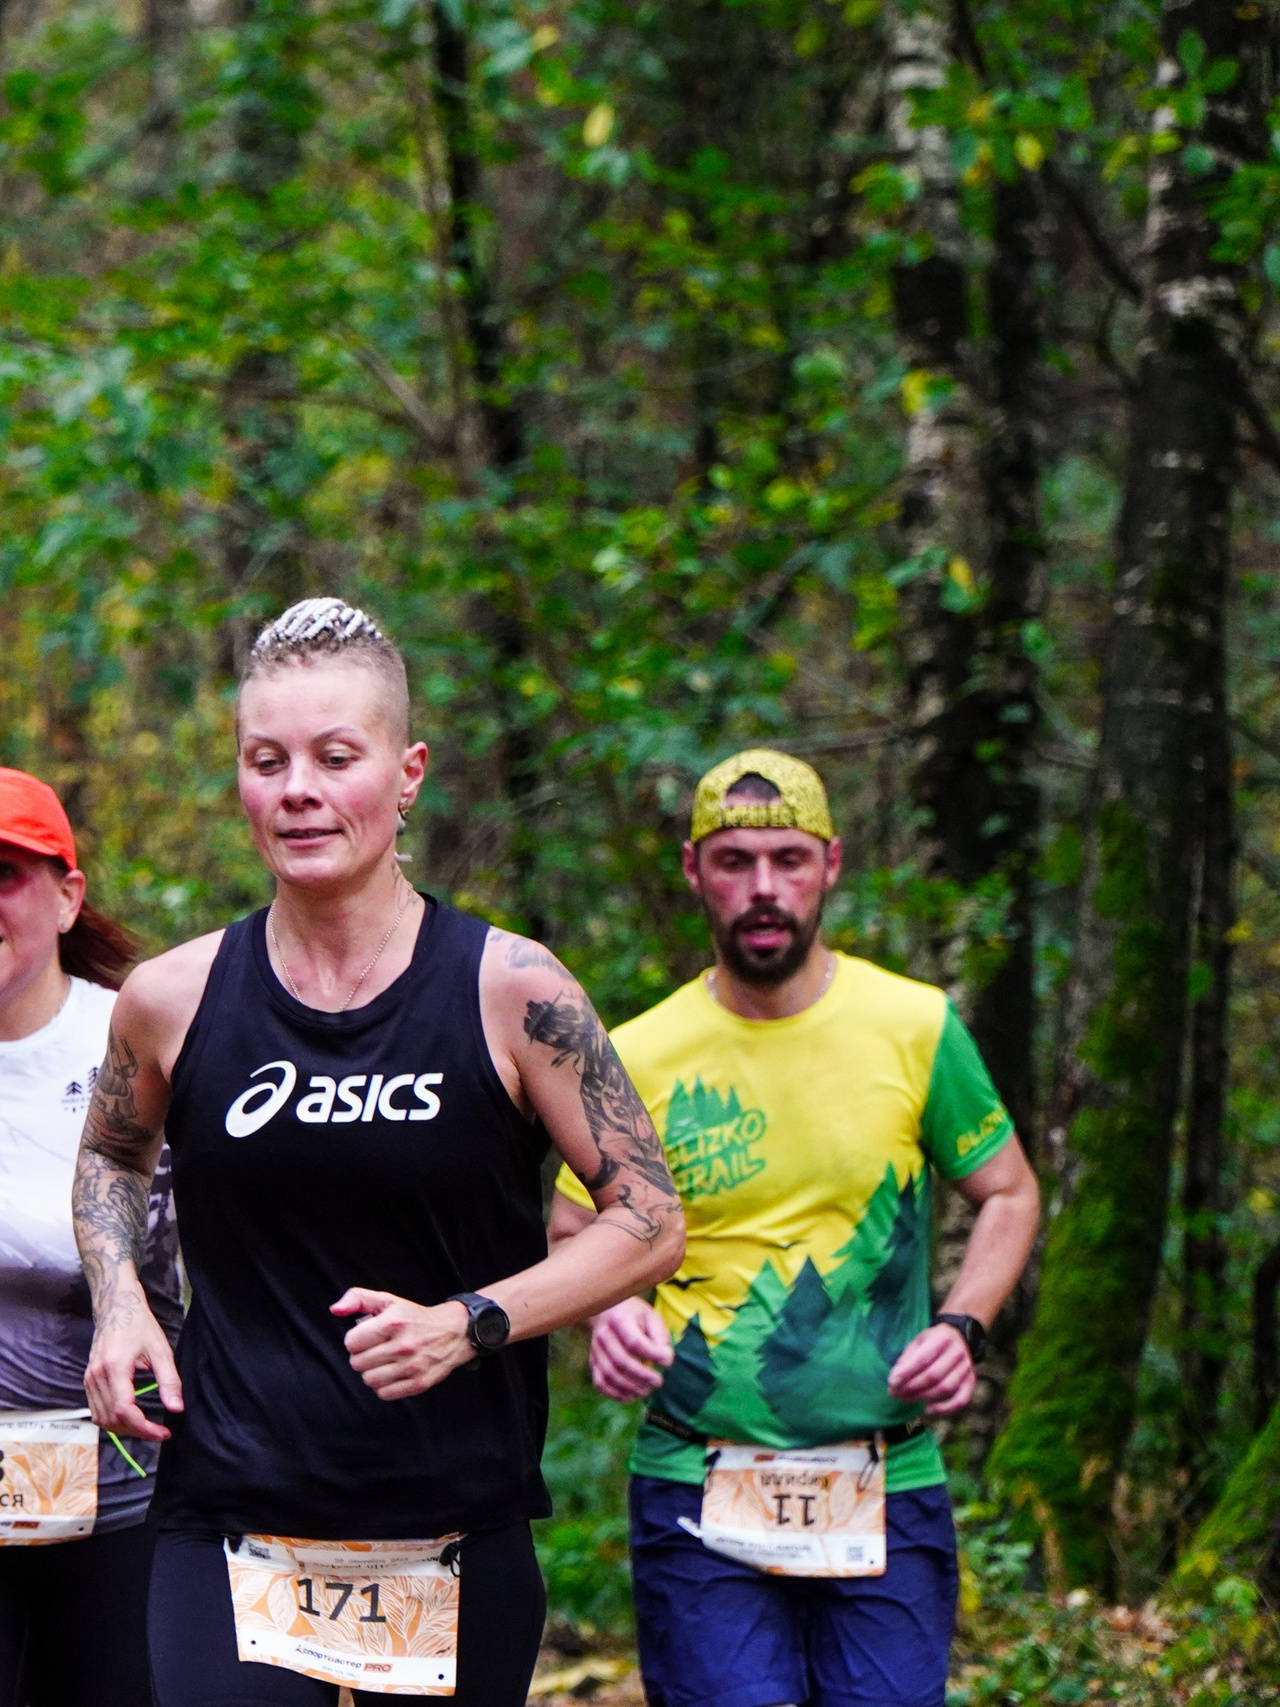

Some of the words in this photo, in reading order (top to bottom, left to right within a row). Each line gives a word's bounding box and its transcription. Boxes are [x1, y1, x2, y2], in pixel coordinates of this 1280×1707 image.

[773, 1494, 816, 1526] 11
[296, 1577, 387, 1623] 171
[363, 1662, 392, 1673] PRO
